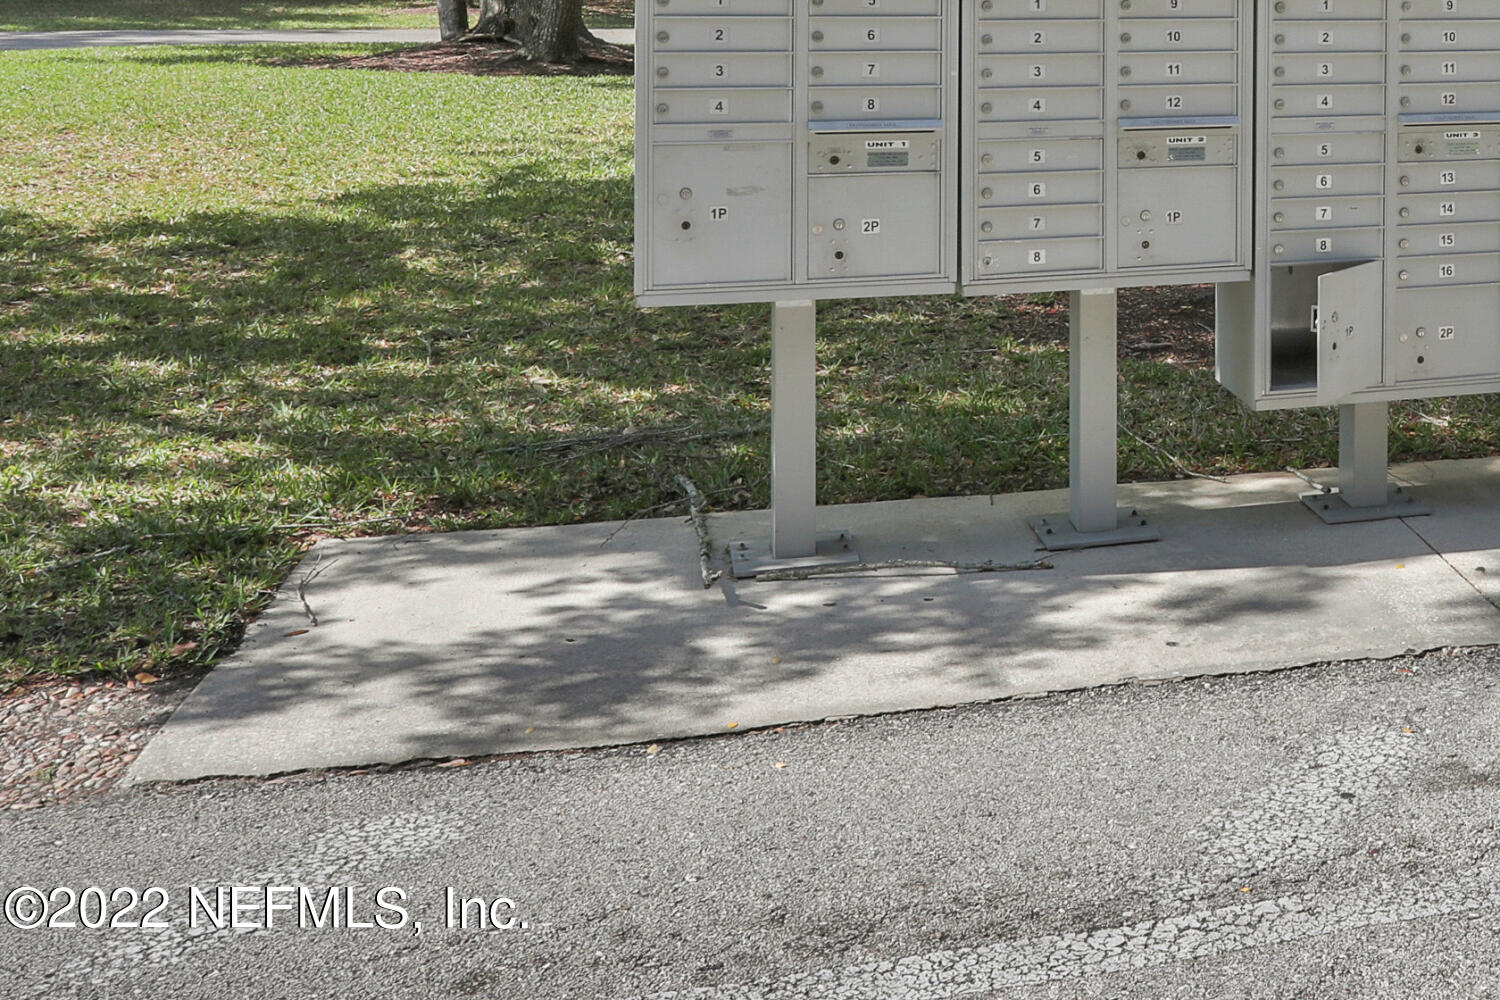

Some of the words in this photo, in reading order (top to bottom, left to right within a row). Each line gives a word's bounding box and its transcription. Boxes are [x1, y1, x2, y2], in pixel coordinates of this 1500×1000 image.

[1323, 0, 1328, 10] 1
[1446, 0, 1454, 10] 9
[715, 29, 724, 41] 2
[867, 29, 875, 41] 6
[1034, 32, 1042, 44] 2
[1167, 31, 1181, 42] 10
[1322, 32, 1329, 43] 2
[1444, 32, 1456, 42] 10
[716, 65, 724, 77] 3
[867, 64, 876, 75] 7
[1034, 66, 1042, 77] 3
[1168, 64, 1180, 75] 11
[1322, 64, 1329, 75] 3
[1444, 63, 1454, 73] 11
[867, 98, 875, 110] 8
[1167, 96, 1181, 108] 12
[1321, 96, 1328, 106] 4
[1443, 94, 1455, 104] 12
[714, 101, 724, 112] 4
[1033, 100, 1041, 110] 4
[1321, 144, 1328, 155] 5
[1034, 151, 1041, 162] 5
[1320, 176, 1328, 187] 6
[1442, 172, 1454, 183] 13
[1033, 184, 1041, 195] 6
[711, 208, 727, 220] 1P
[1320, 208, 1328, 218] 7
[1442, 204, 1453, 214] 14
[1167, 211, 1181, 222] 1P
[864, 220, 879, 232] 2P
[1033, 218, 1041, 228] 7
[1441, 234, 1453, 245] 15
[1320, 240, 1327, 251] 8
[1033, 251, 1041, 262] 8
[1441, 265, 1453, 276] 16
[1440, 328, 1454, 338] 2P
